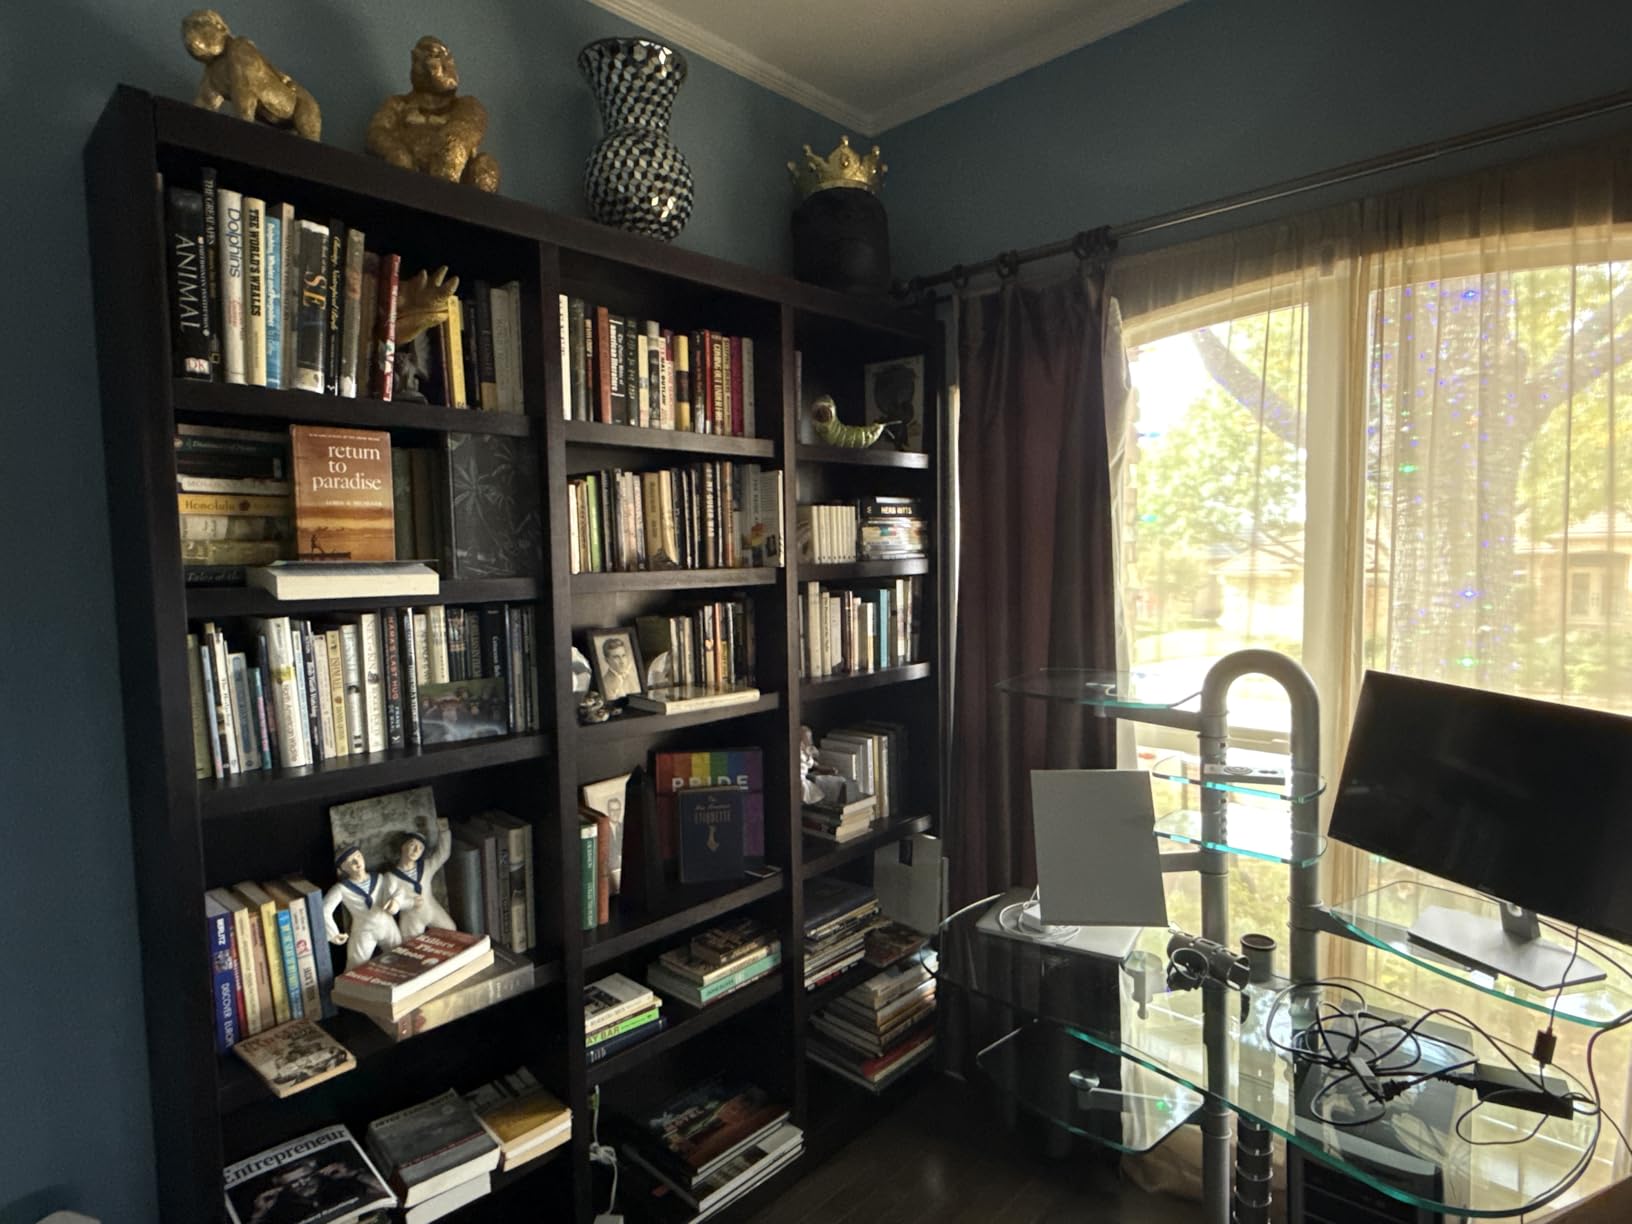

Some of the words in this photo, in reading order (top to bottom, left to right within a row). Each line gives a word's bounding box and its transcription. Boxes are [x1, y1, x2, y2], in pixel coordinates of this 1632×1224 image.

[249, 209, 259, 228] THE
[225, 208, 242, 277] Dolphins
[250, 231, 260, 273] WORLD'S
[175, 233, 200, 334] ANIMAL
[251, 275, 261, 316] WHALES
[328, 446, 380, 460] return
[328, 460, 347, 473] to
[312, 472, 382, 491] paradise
[185, 500, 235, 511] Honolulu
[389, 654, 397, 678] LAST
[282, 685, 290, 702] North
[391, 680, 399, 700] HUG
[671, 775, 749, 792] PRIDE
[216, 918, 226, 946] BERLITZ
[416, 934, 455, 948] Killers
[392, 947, 425, 960] Moon
[345, 971, 373, 982] David
[221, 982, 233, 1019] DISCOVER
[224, 1129, 346, 1184] Entrepreneur
